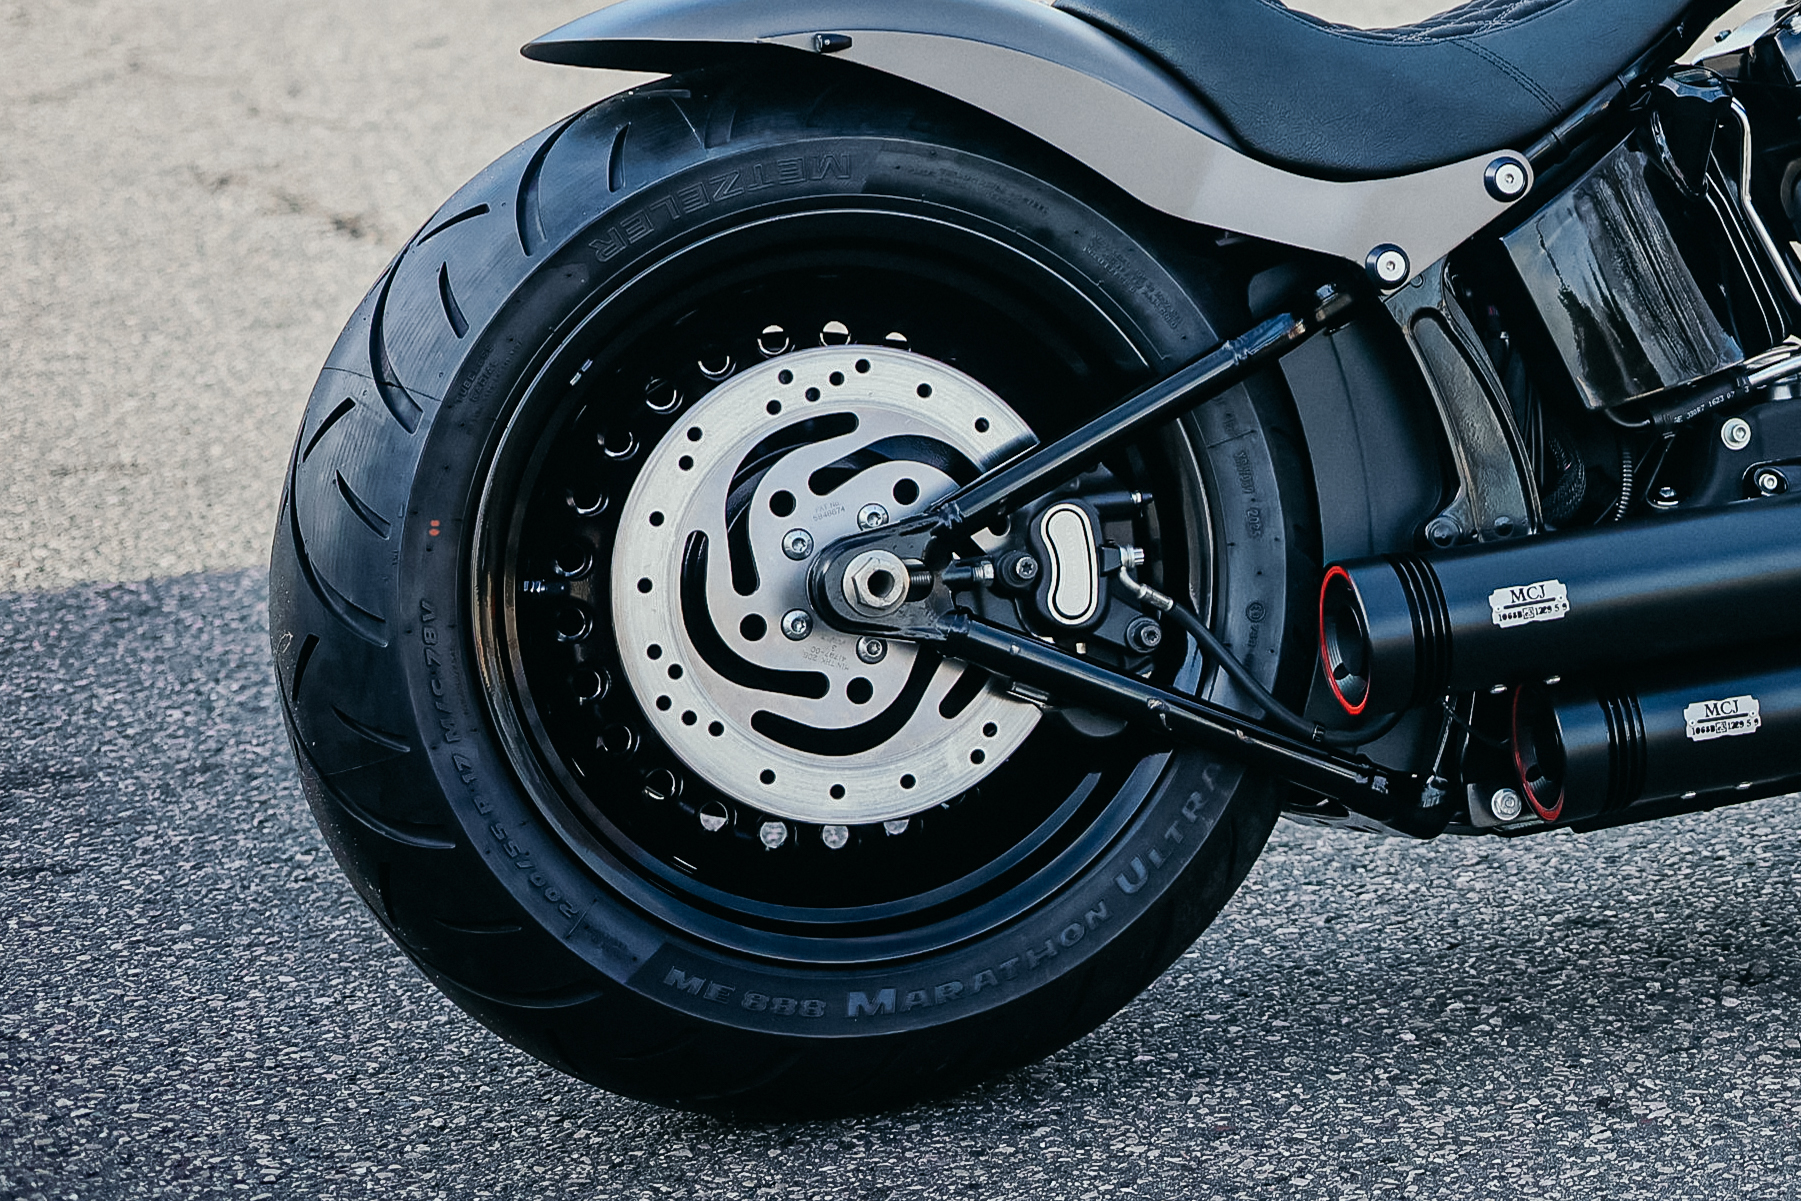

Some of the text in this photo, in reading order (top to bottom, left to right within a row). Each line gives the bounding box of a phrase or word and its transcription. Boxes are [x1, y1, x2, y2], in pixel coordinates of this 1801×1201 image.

[588, 152, 850, 263] METZELER
[1510, 584, 1546, 604] MCJ
[1704, 700, 1739, 718] MCJ
[663, 965, 737, 1002] ME
